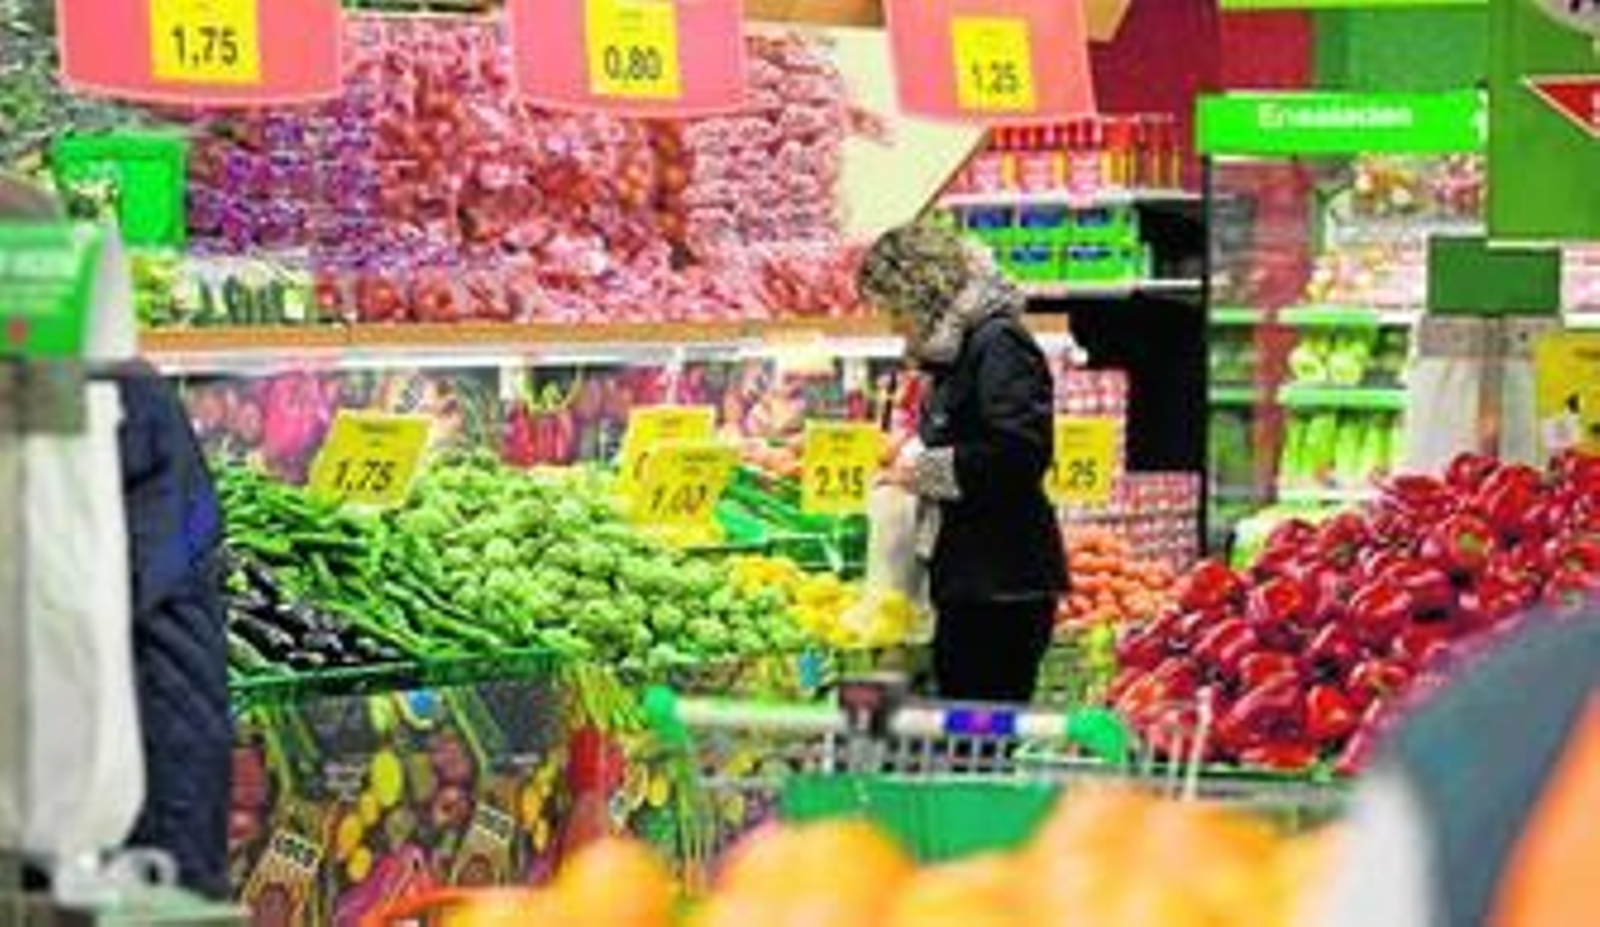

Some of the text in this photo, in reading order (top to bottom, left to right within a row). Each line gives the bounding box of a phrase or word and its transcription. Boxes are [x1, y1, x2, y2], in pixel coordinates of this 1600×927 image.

[171, 25, 238, 68] 1,75
[603, 45, 662, 84] 0,80
[971, 60, 1018, 96] 1,25
[335, 459, 393, 493] 1,75
[815, 465, 864, 500] 2,15
